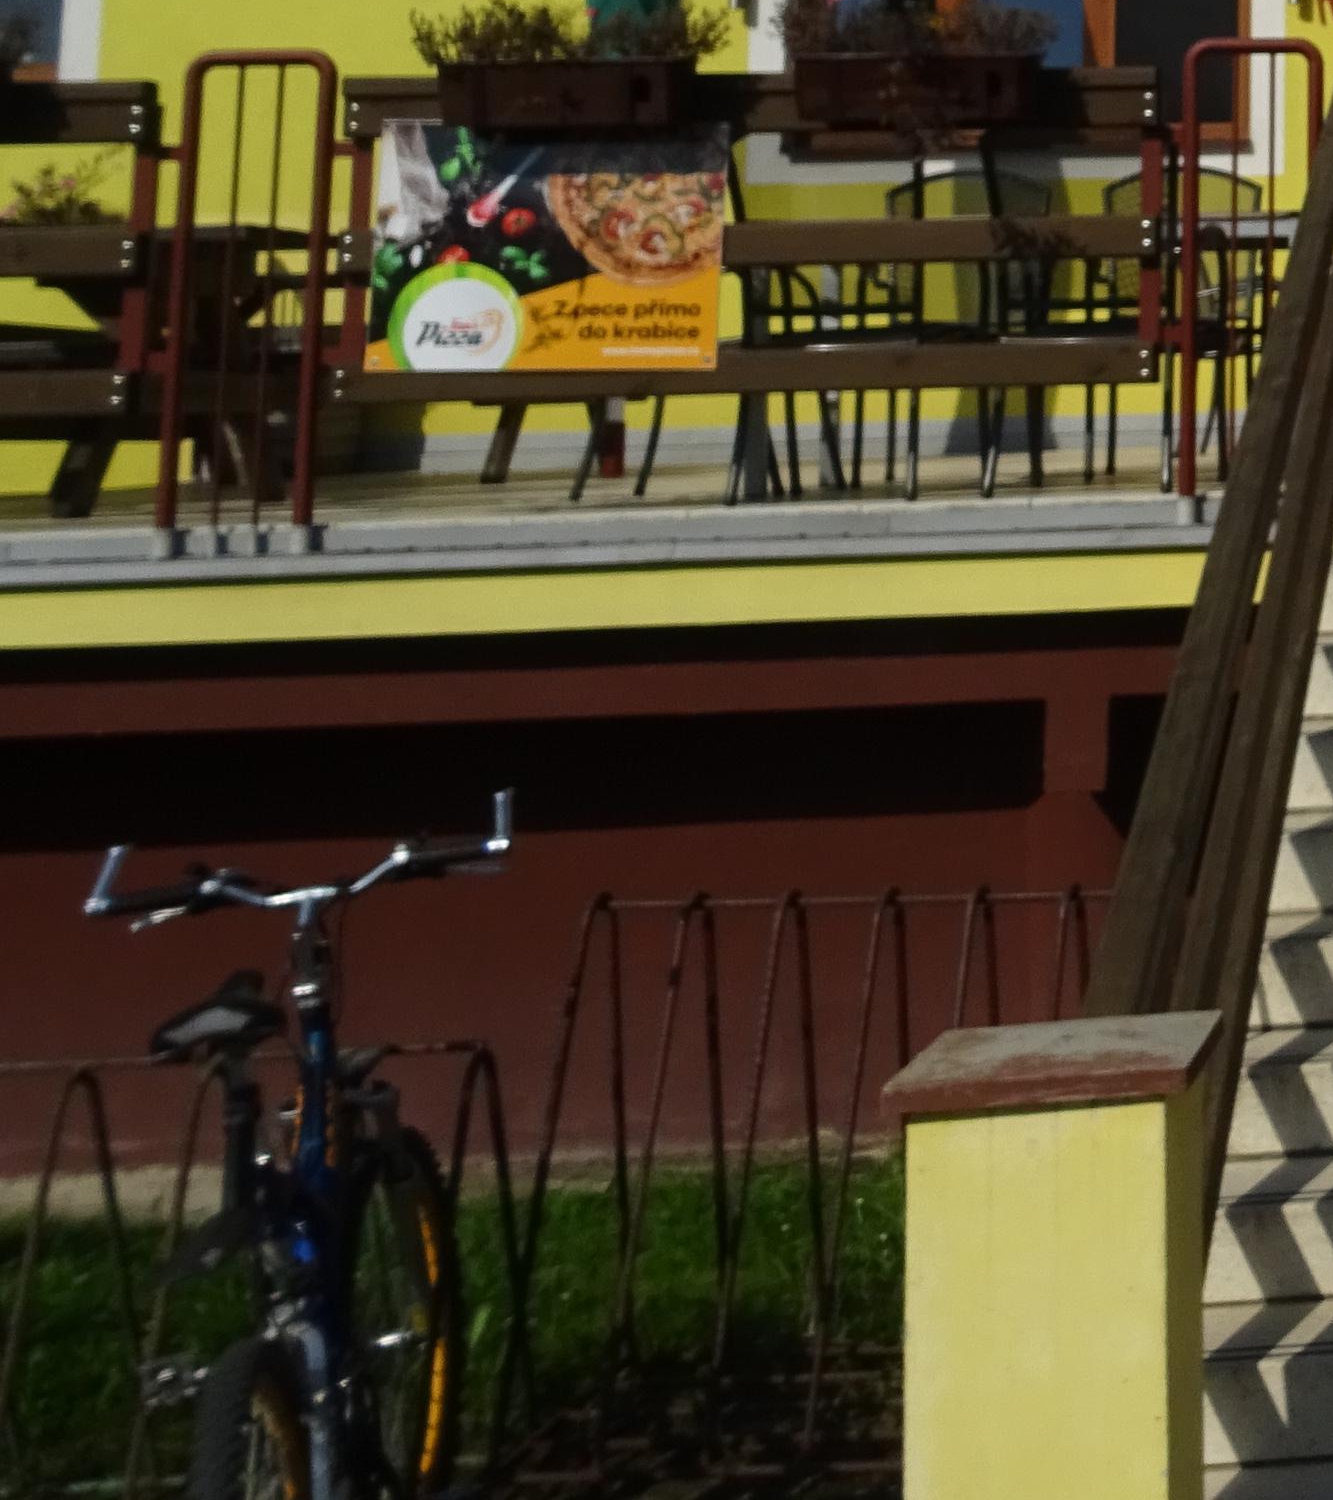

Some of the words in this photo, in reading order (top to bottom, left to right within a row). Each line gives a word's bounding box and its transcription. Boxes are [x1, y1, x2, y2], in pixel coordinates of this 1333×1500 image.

[573, 303, 628, 321] pece
[633, 299, 701, 321] přímo
[416, 320, 483, 348] Pizza
[578, 322, 607, 340] do
[613, 322, 700, 340] krabice
